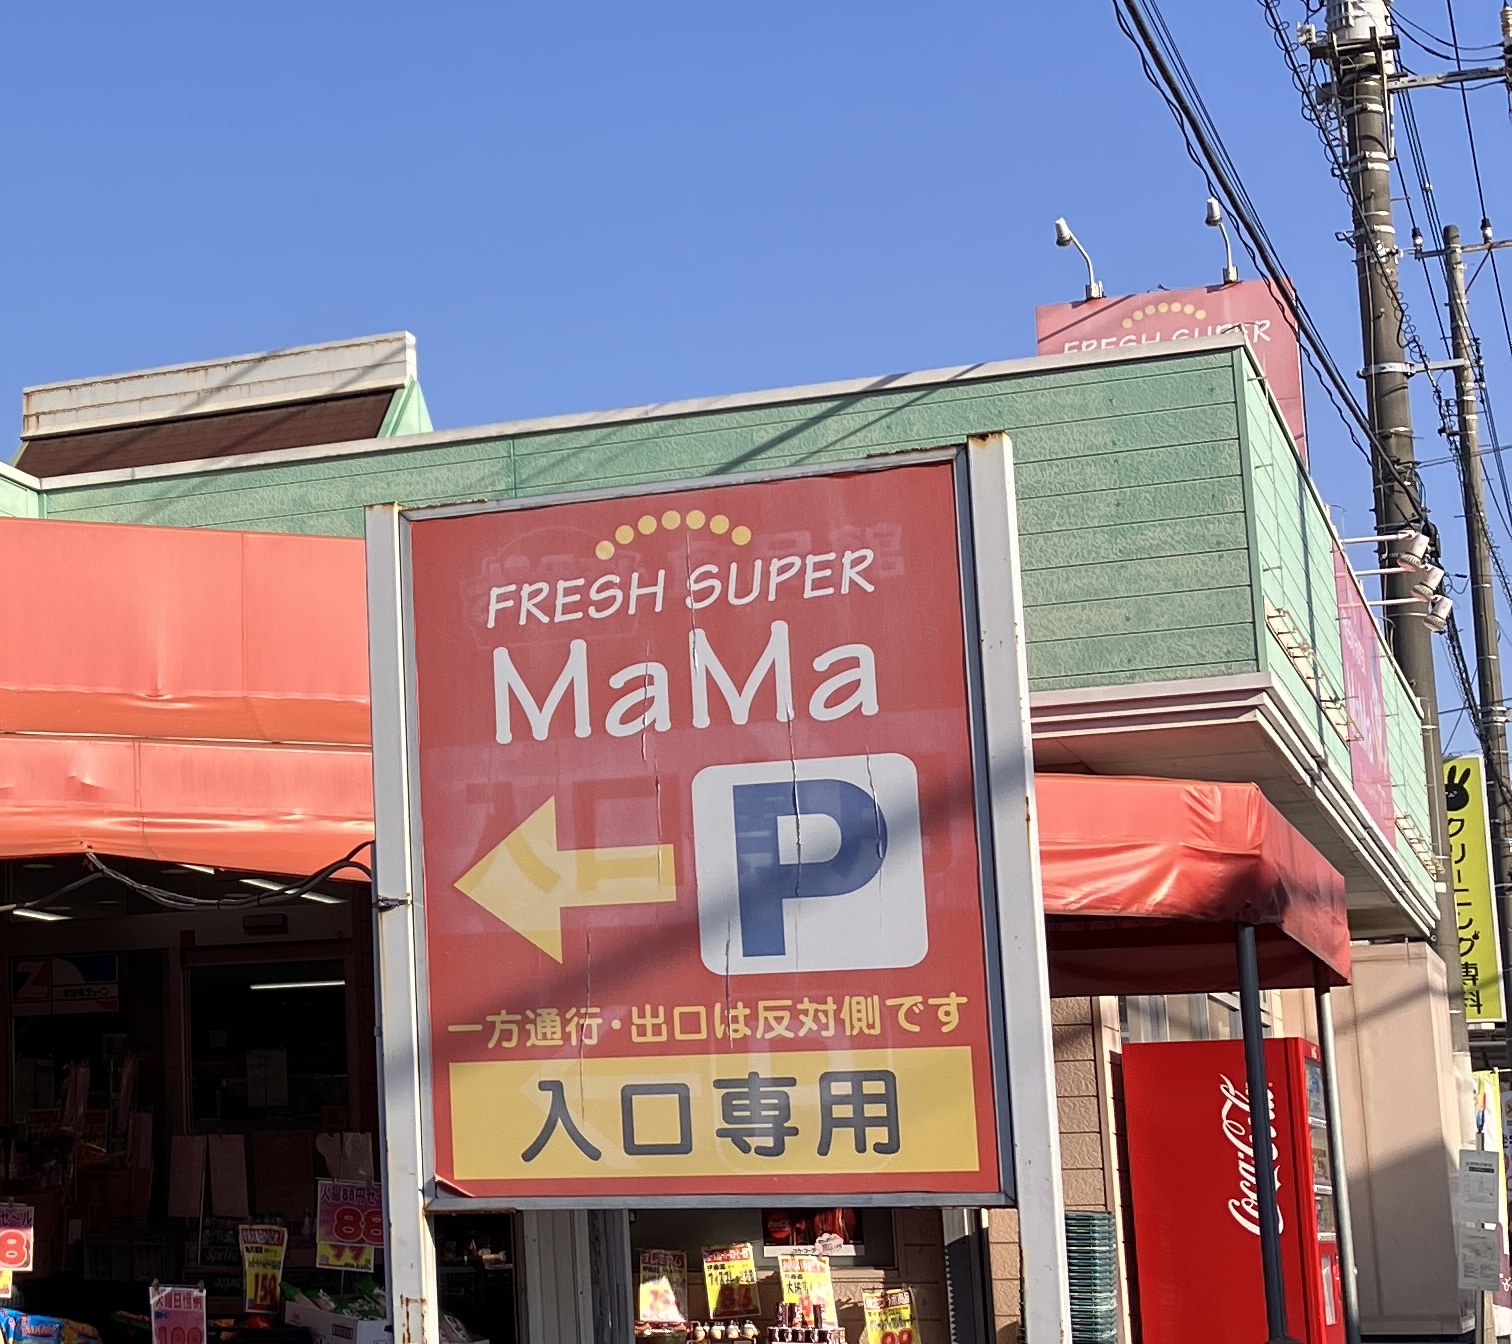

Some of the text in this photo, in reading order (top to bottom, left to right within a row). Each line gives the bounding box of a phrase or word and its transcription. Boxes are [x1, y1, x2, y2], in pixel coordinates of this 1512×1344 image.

[486, 548, 876, 629] FRESH SUPER
[492, 619, 881, 745] MaMa
[731, 778, 888, 958] P
[447, 991, 969, 1050] 一方通行・出口は反対側です
[521, 1068, 903, 1164] 入口専用
